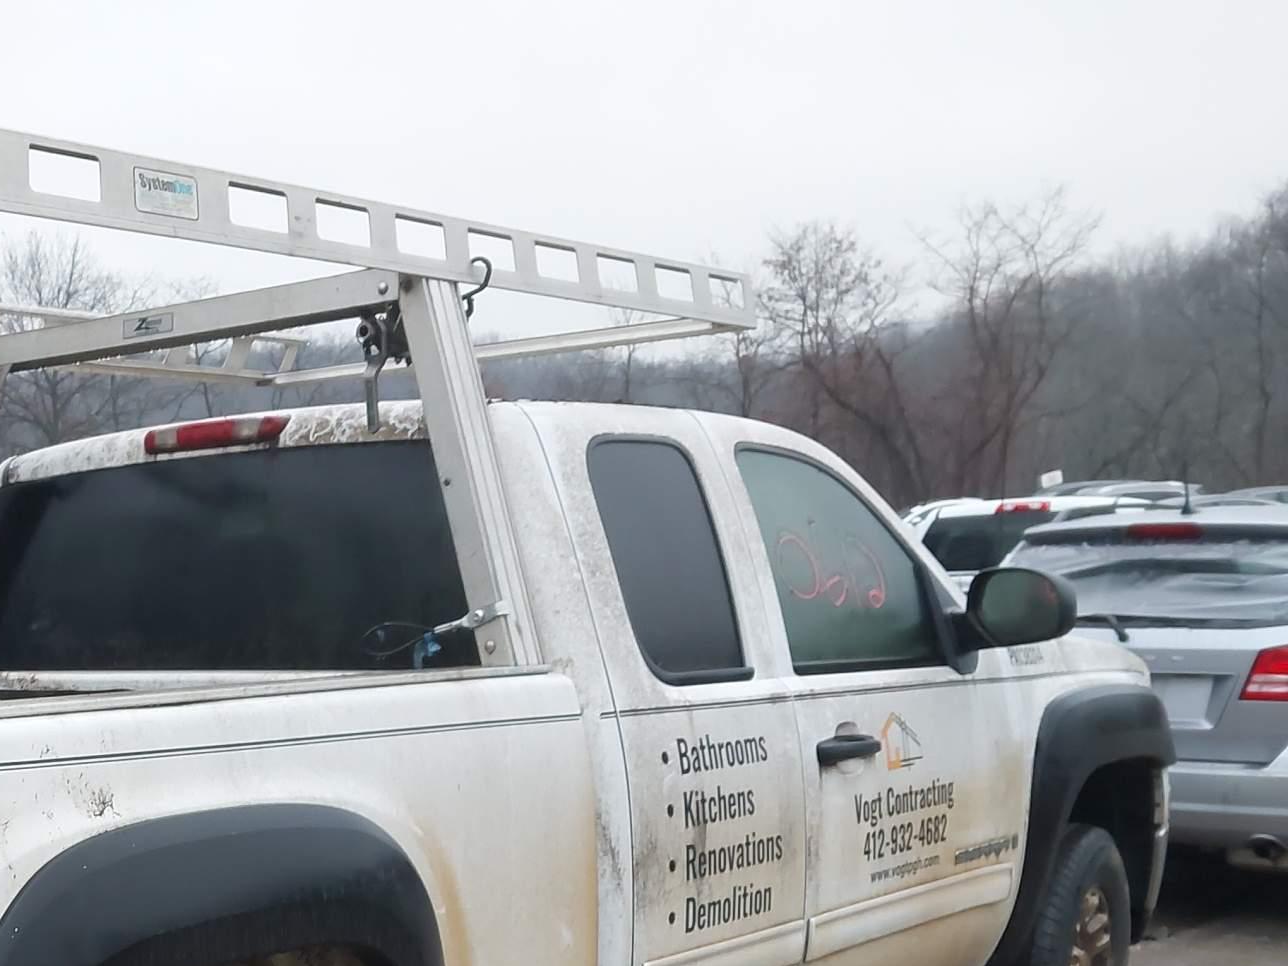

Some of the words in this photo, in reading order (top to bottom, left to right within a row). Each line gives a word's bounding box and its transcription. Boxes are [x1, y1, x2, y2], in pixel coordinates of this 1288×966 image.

[676, 734, 768, 775] Bathrooms
[683, 786, 755, 830] Kitchens
[854, 793, 884, 828] Vogt
[886, 778, 955, 816] Contracting
[685, 832, 783, 882] Renovations
[863, 815, 947, 862] 412-932-4682
[684, 884, 772, 934] Demolition
